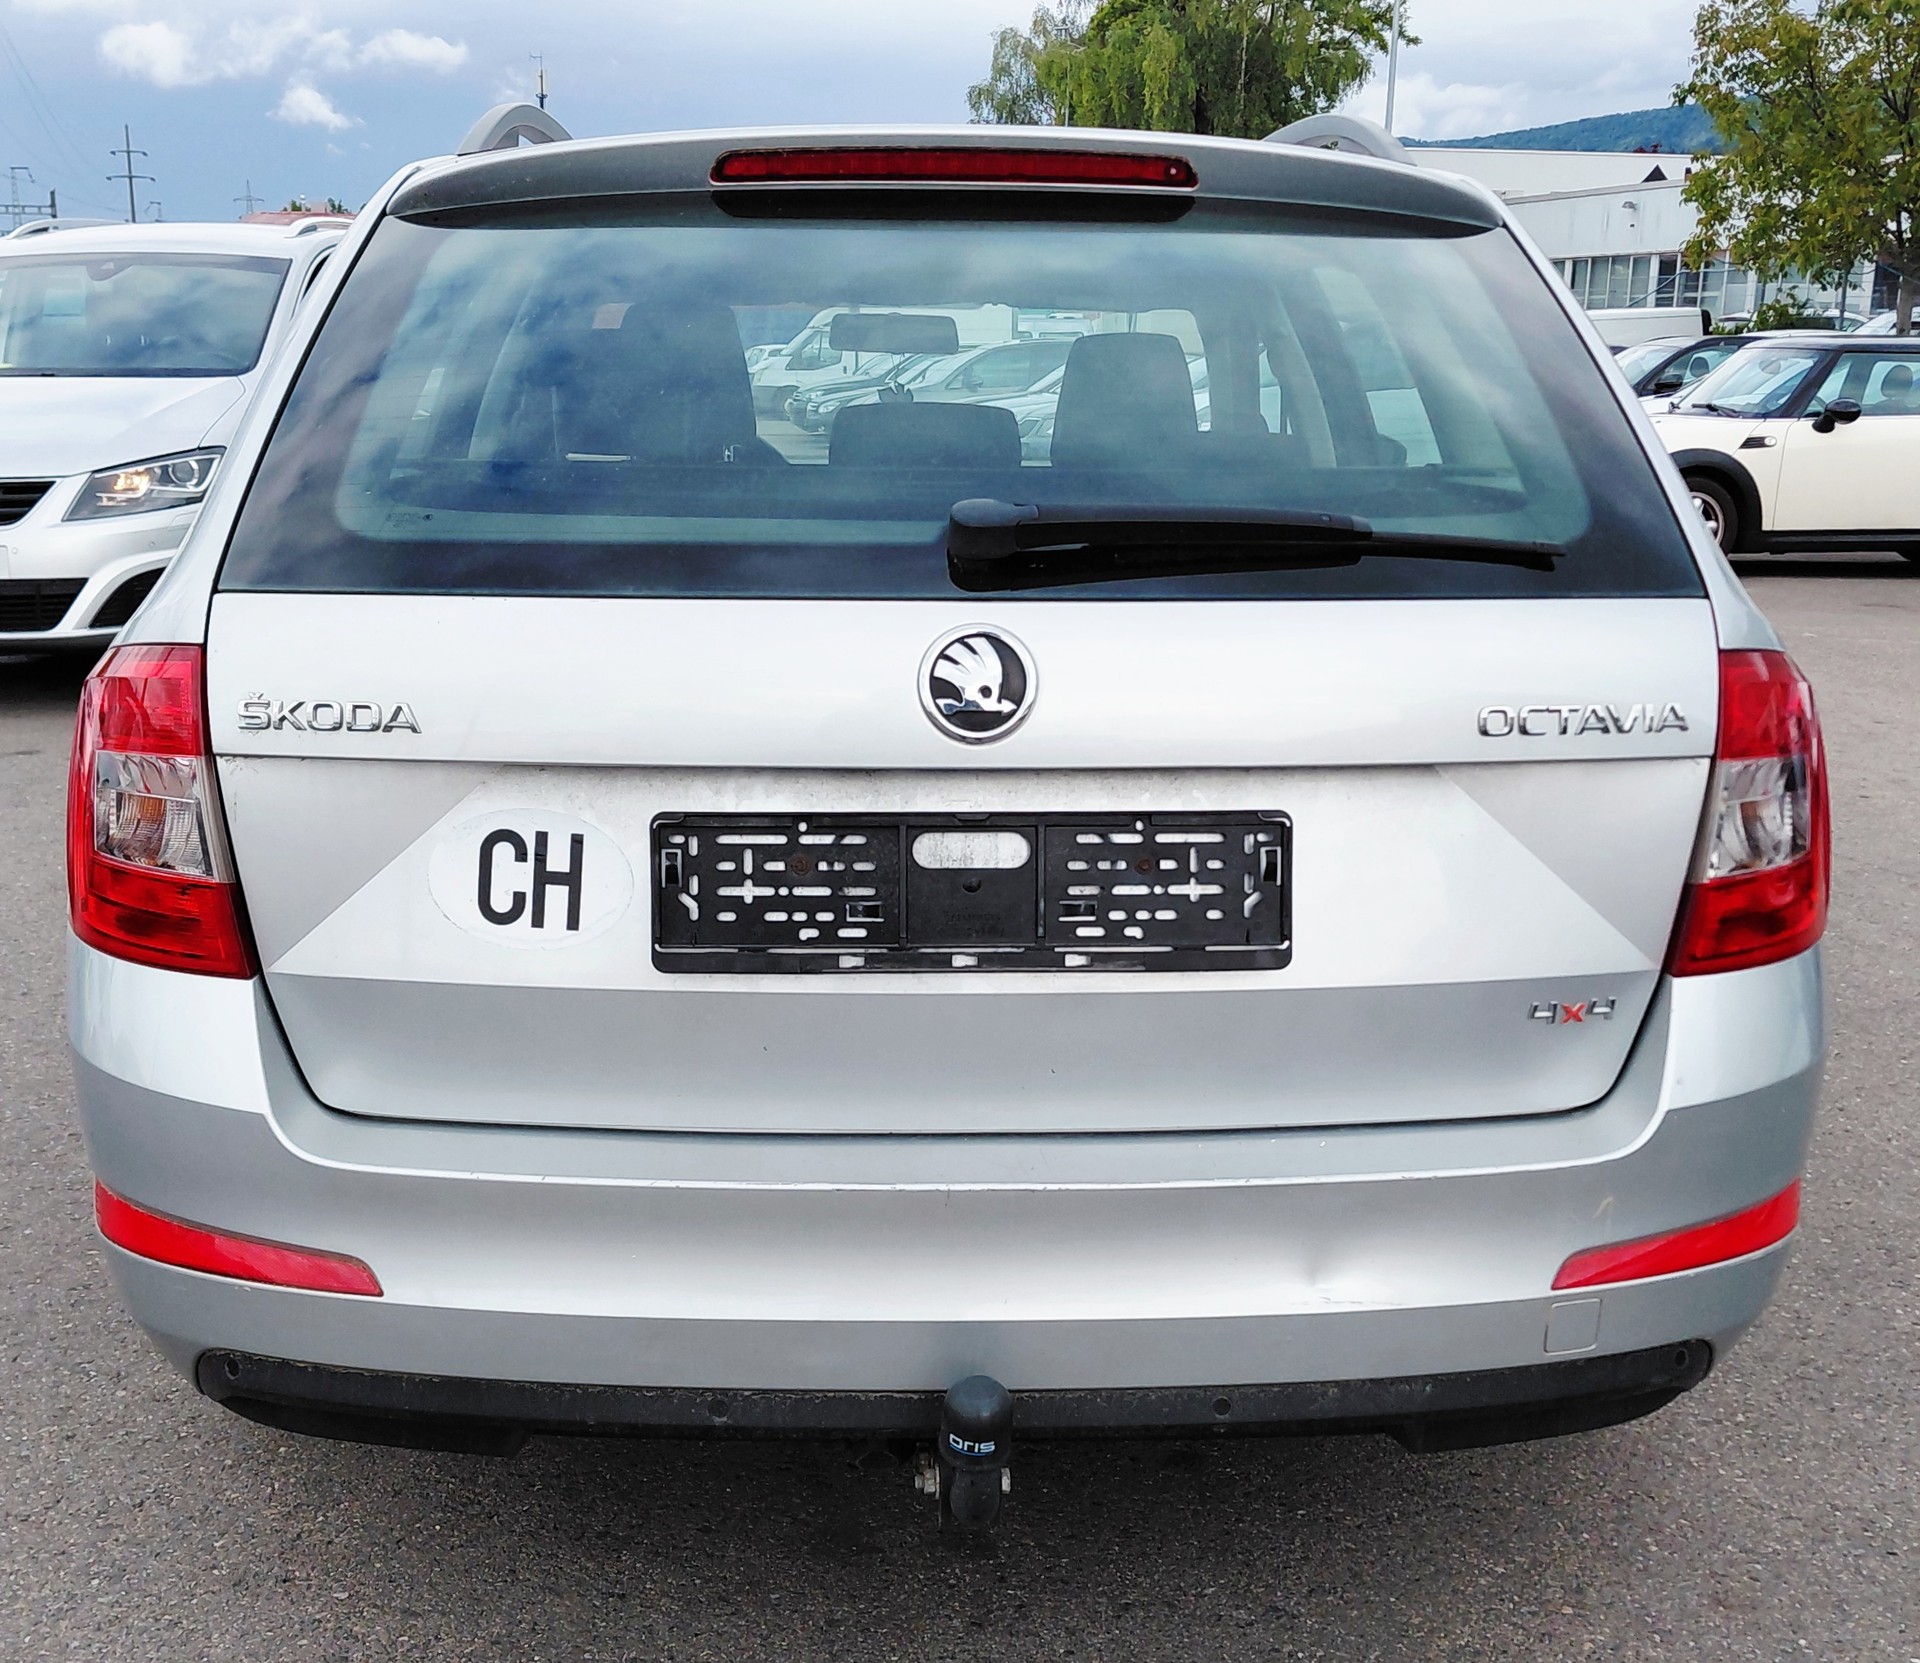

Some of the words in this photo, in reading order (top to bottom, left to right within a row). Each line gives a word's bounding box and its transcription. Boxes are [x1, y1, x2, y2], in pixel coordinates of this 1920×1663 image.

[237, 692, 422, 734] ŠKODA
[1478, 704, 1689, 737] OCTAVIA
[478, 828, 584, 931] CH
